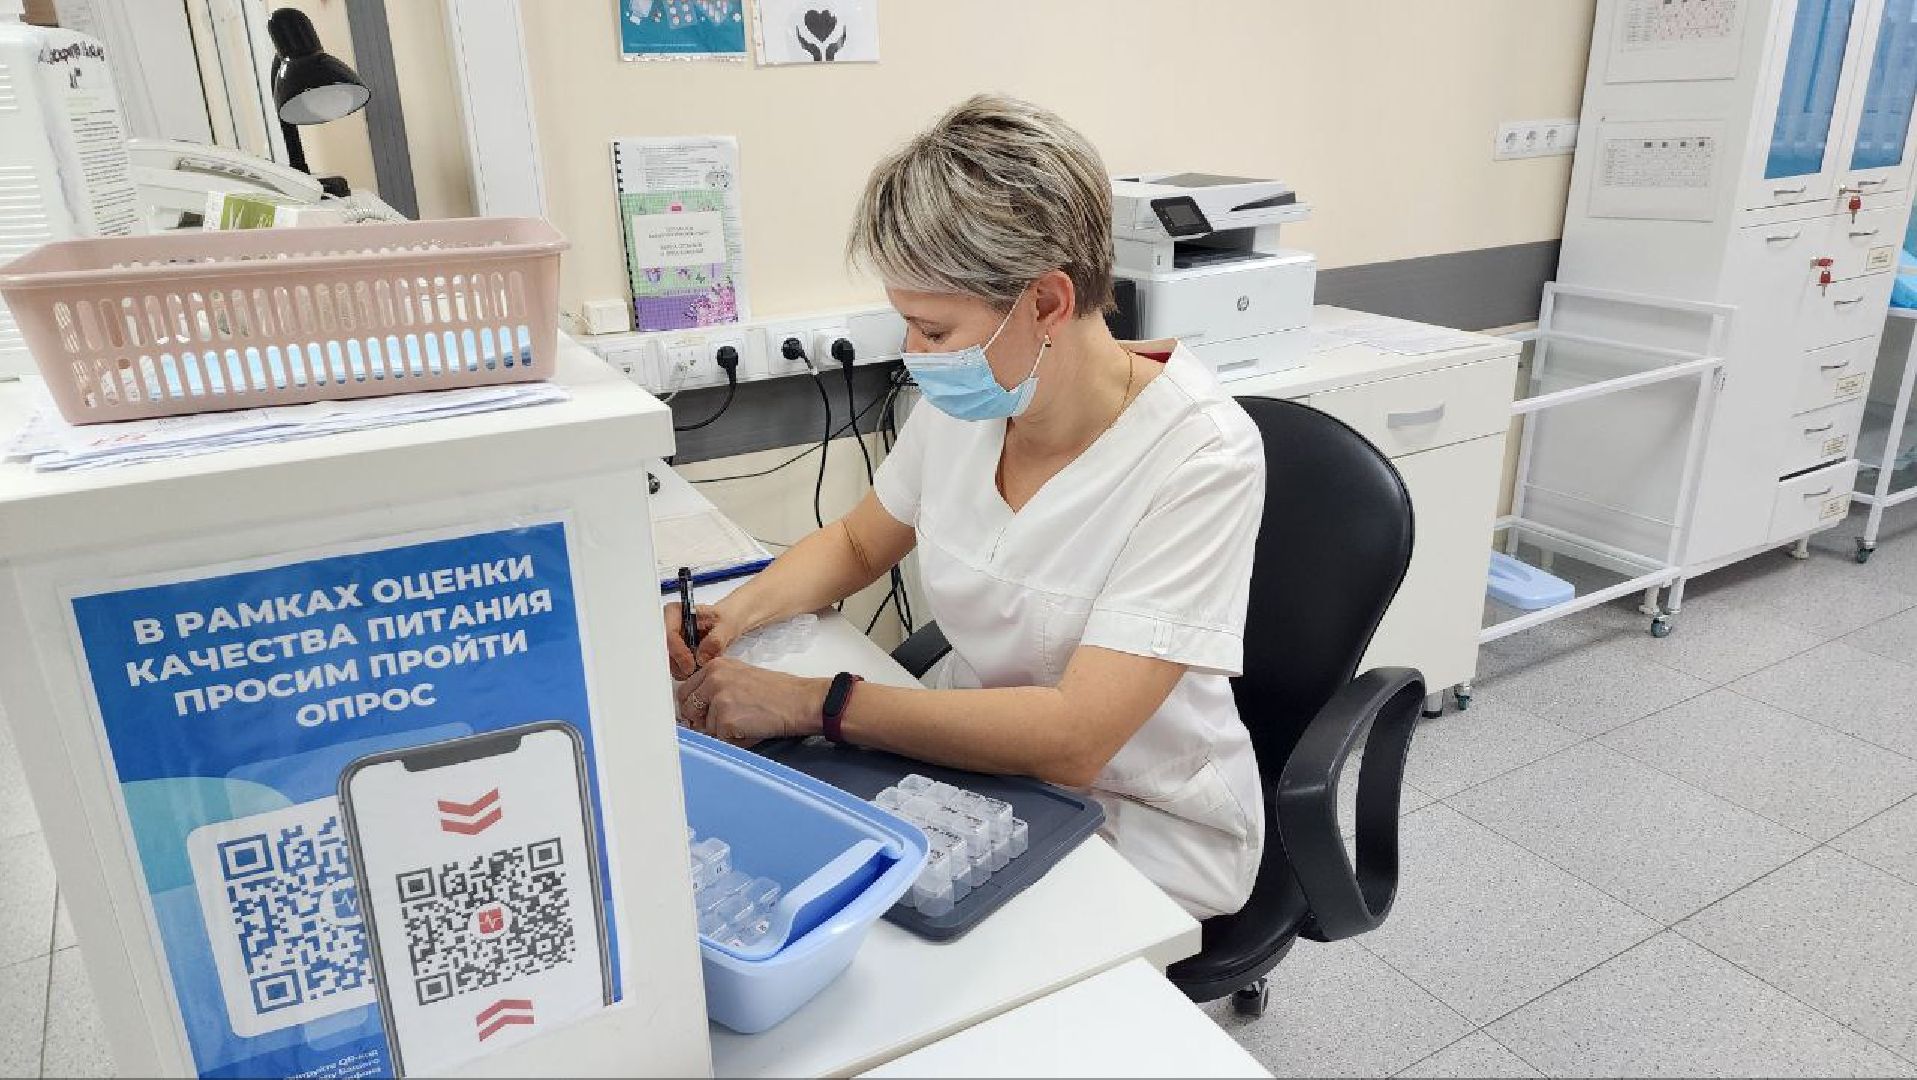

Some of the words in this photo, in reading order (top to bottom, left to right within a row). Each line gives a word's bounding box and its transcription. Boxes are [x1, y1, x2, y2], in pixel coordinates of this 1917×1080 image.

[126, 623, 359, 687] КАЧЕСТВА
[367, 589, 553, 642] ПИТАНИЯ
[133, 618, 164, 645] В
[175, 583, 363, 639] РАМКАХ
[371, 554, 534, 603] ОЦЕНКИ
[174, 659, 360, 717] ПРОСИМ
[369, 629, 529, 679] ПРОЙТИ
[295, 683, 437, 728] ОПРОС
